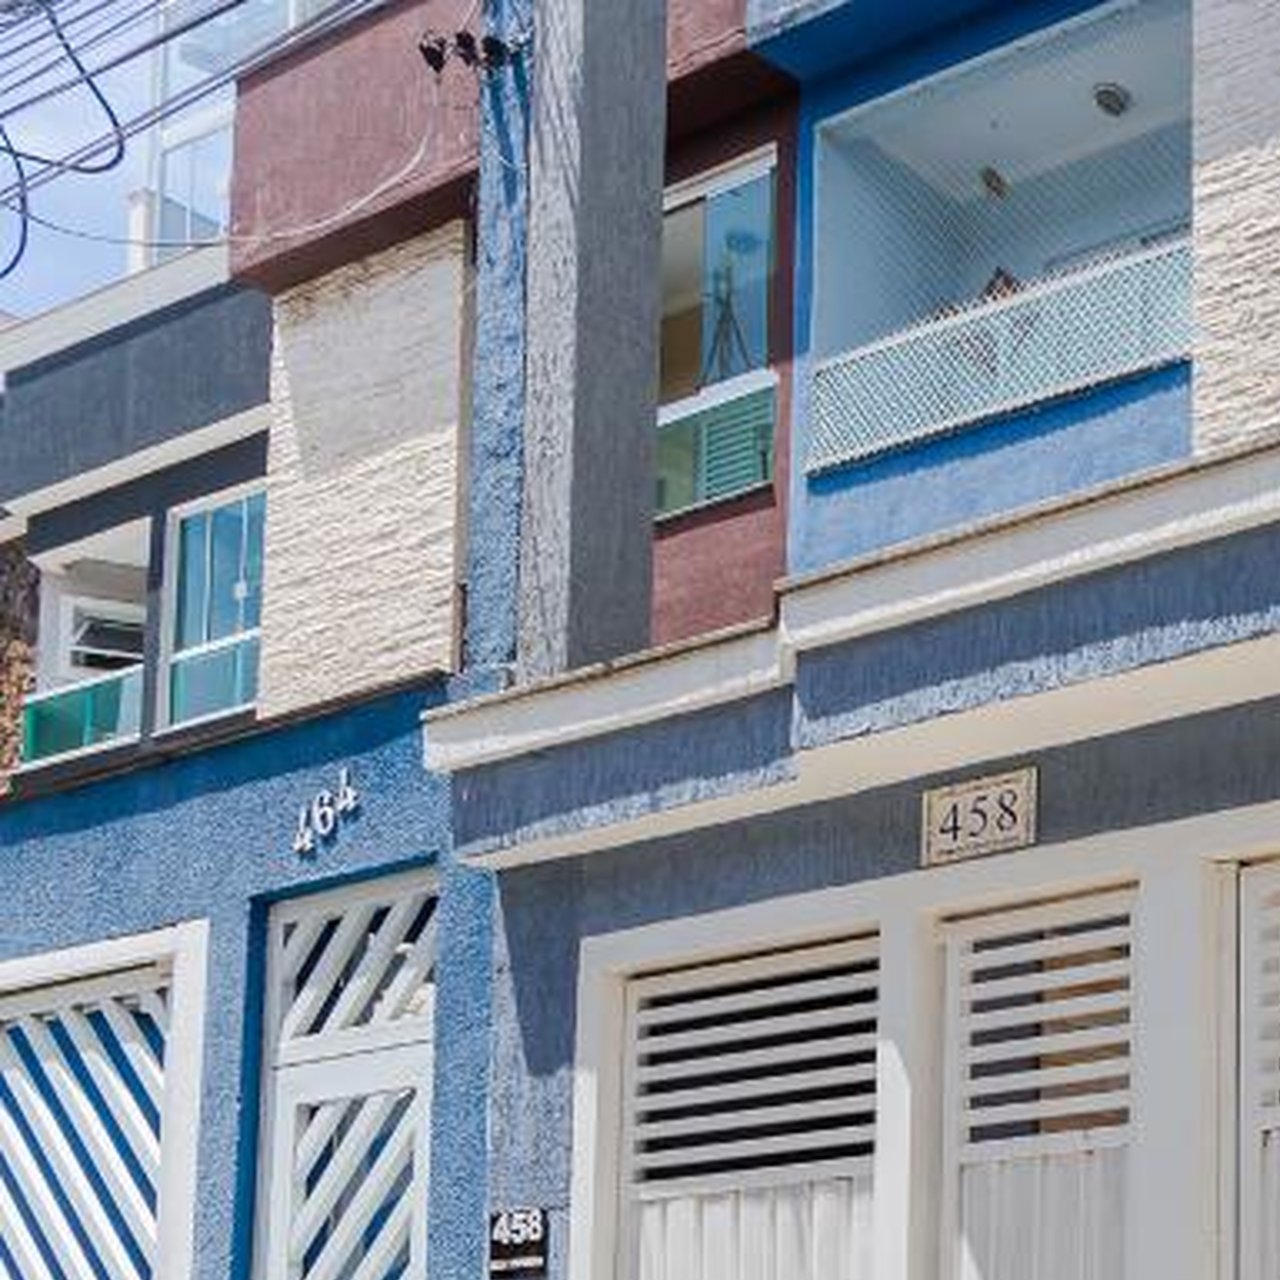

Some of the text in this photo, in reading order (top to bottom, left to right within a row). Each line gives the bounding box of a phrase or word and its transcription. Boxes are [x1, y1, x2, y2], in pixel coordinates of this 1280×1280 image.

[292, 767, 358, 852] 464
[939, 789, 1018, 841] 458
[492, 1208, 544, 1245] 458
